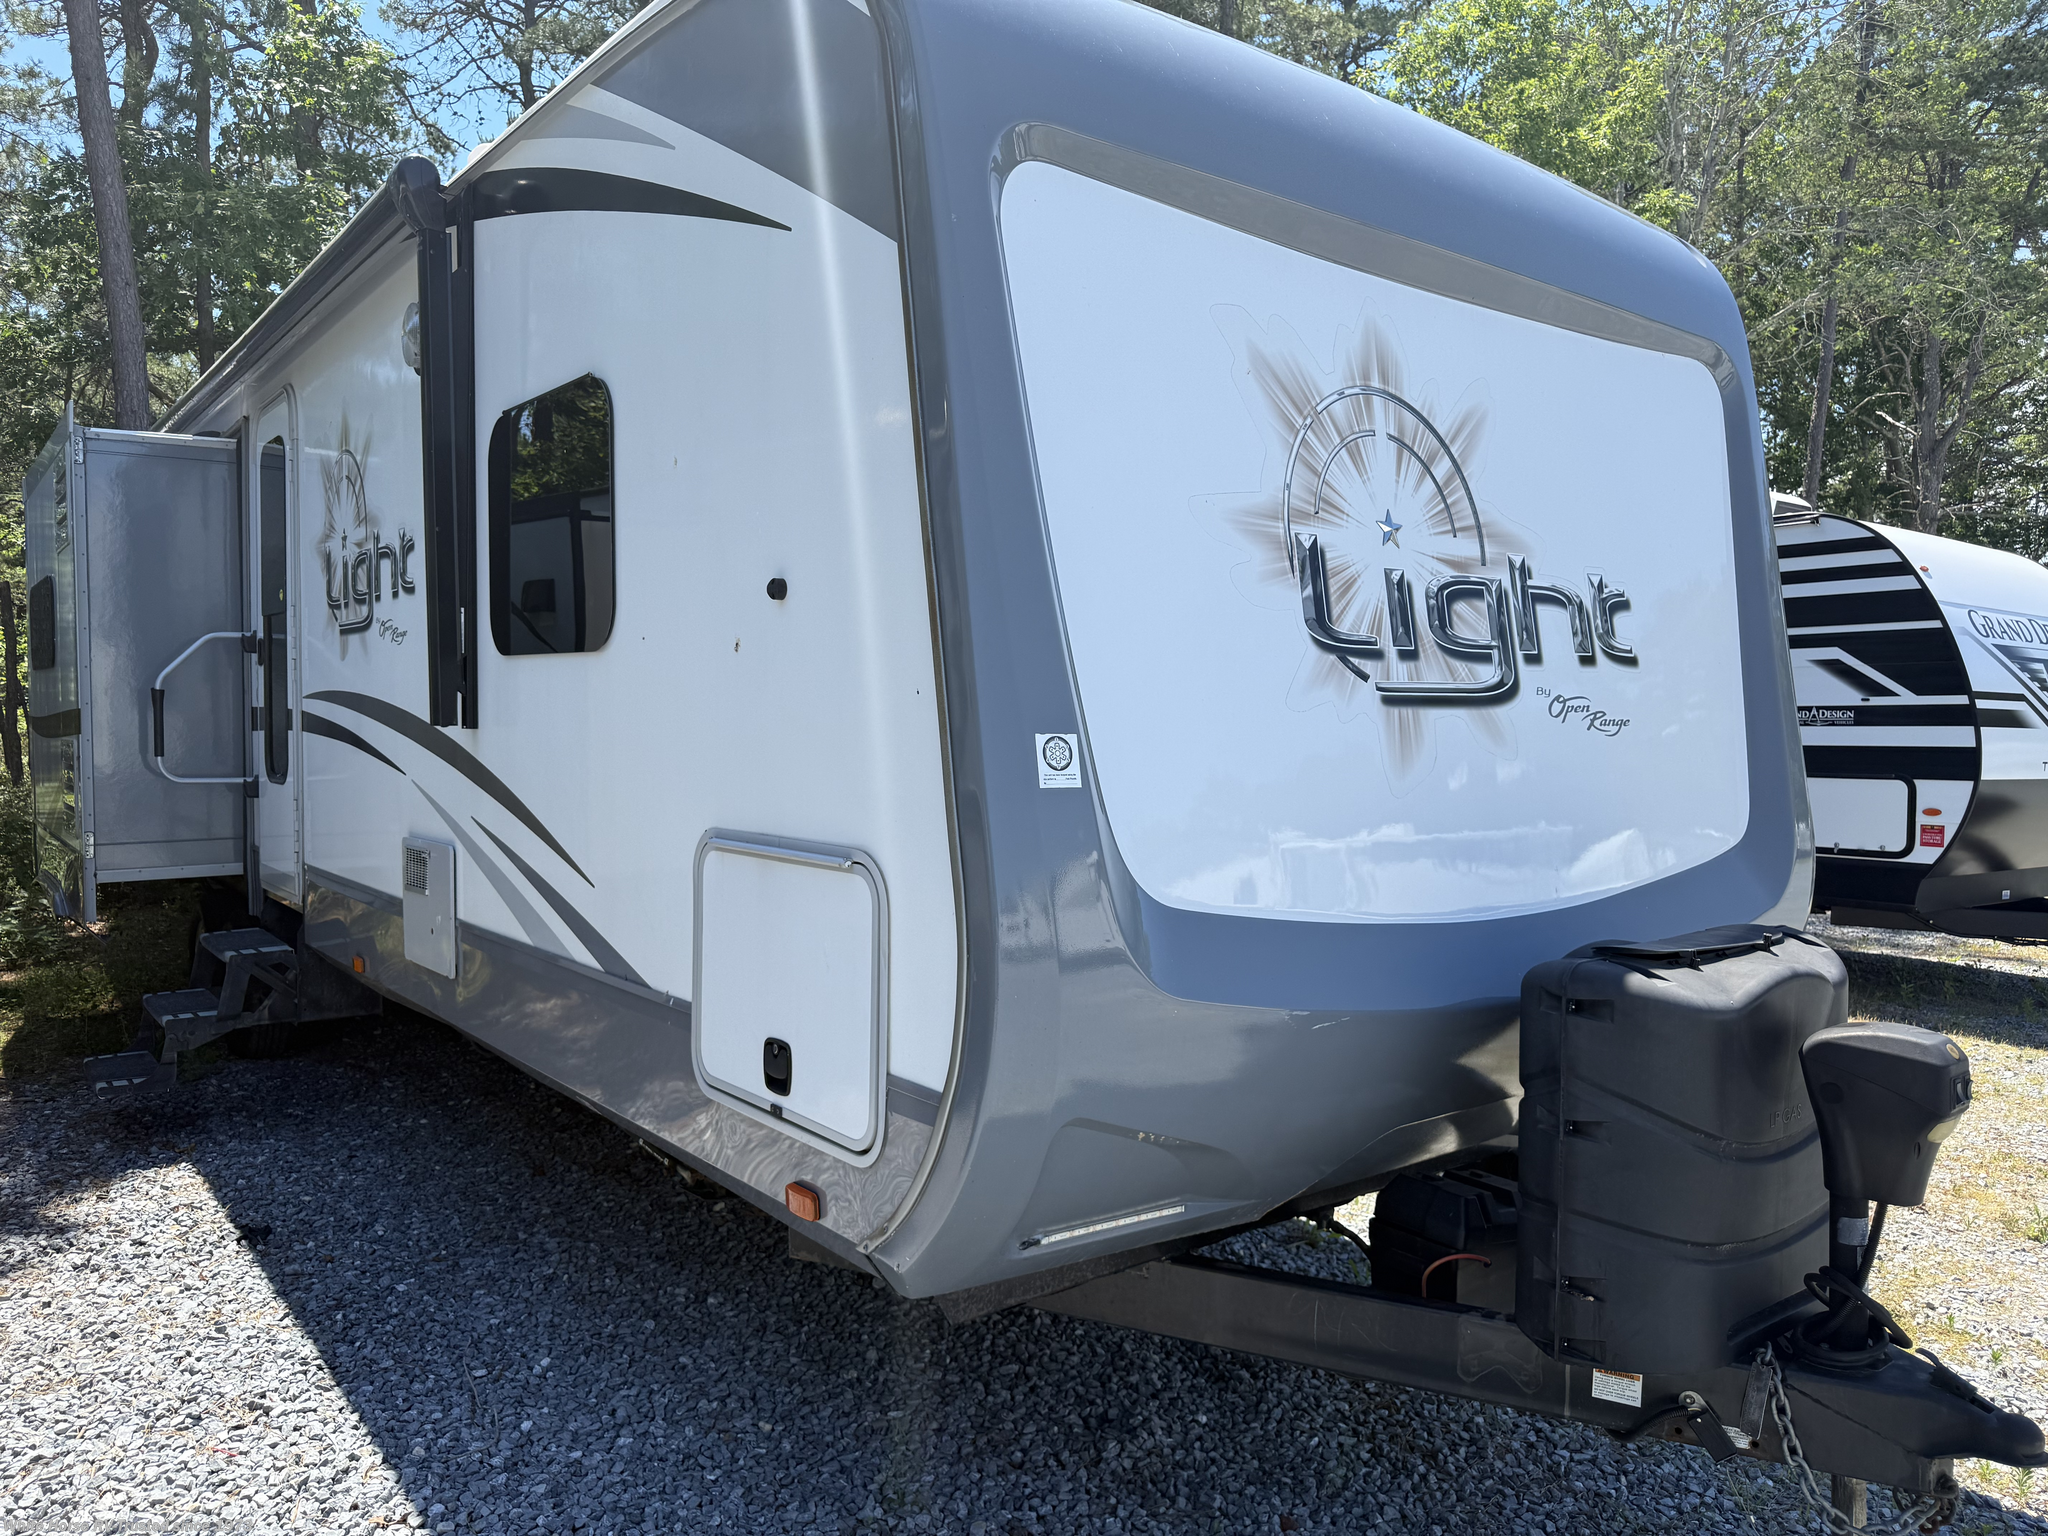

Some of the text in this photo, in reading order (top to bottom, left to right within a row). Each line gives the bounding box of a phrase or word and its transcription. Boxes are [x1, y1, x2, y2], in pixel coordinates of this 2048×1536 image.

[325, 527, 415, 633] Light
[1294, 532, 1635, 699] Light
[1967, 609, 2034, 643] GRAND
[1536, 686, 1552, 698] By
[1548, 694, 1592, 724] Open
[1818, 709, 1855, 719] DESIGN
[1581, 710, 1631, 737] Range
[1782, 1103, 1803, 1124] GAS
